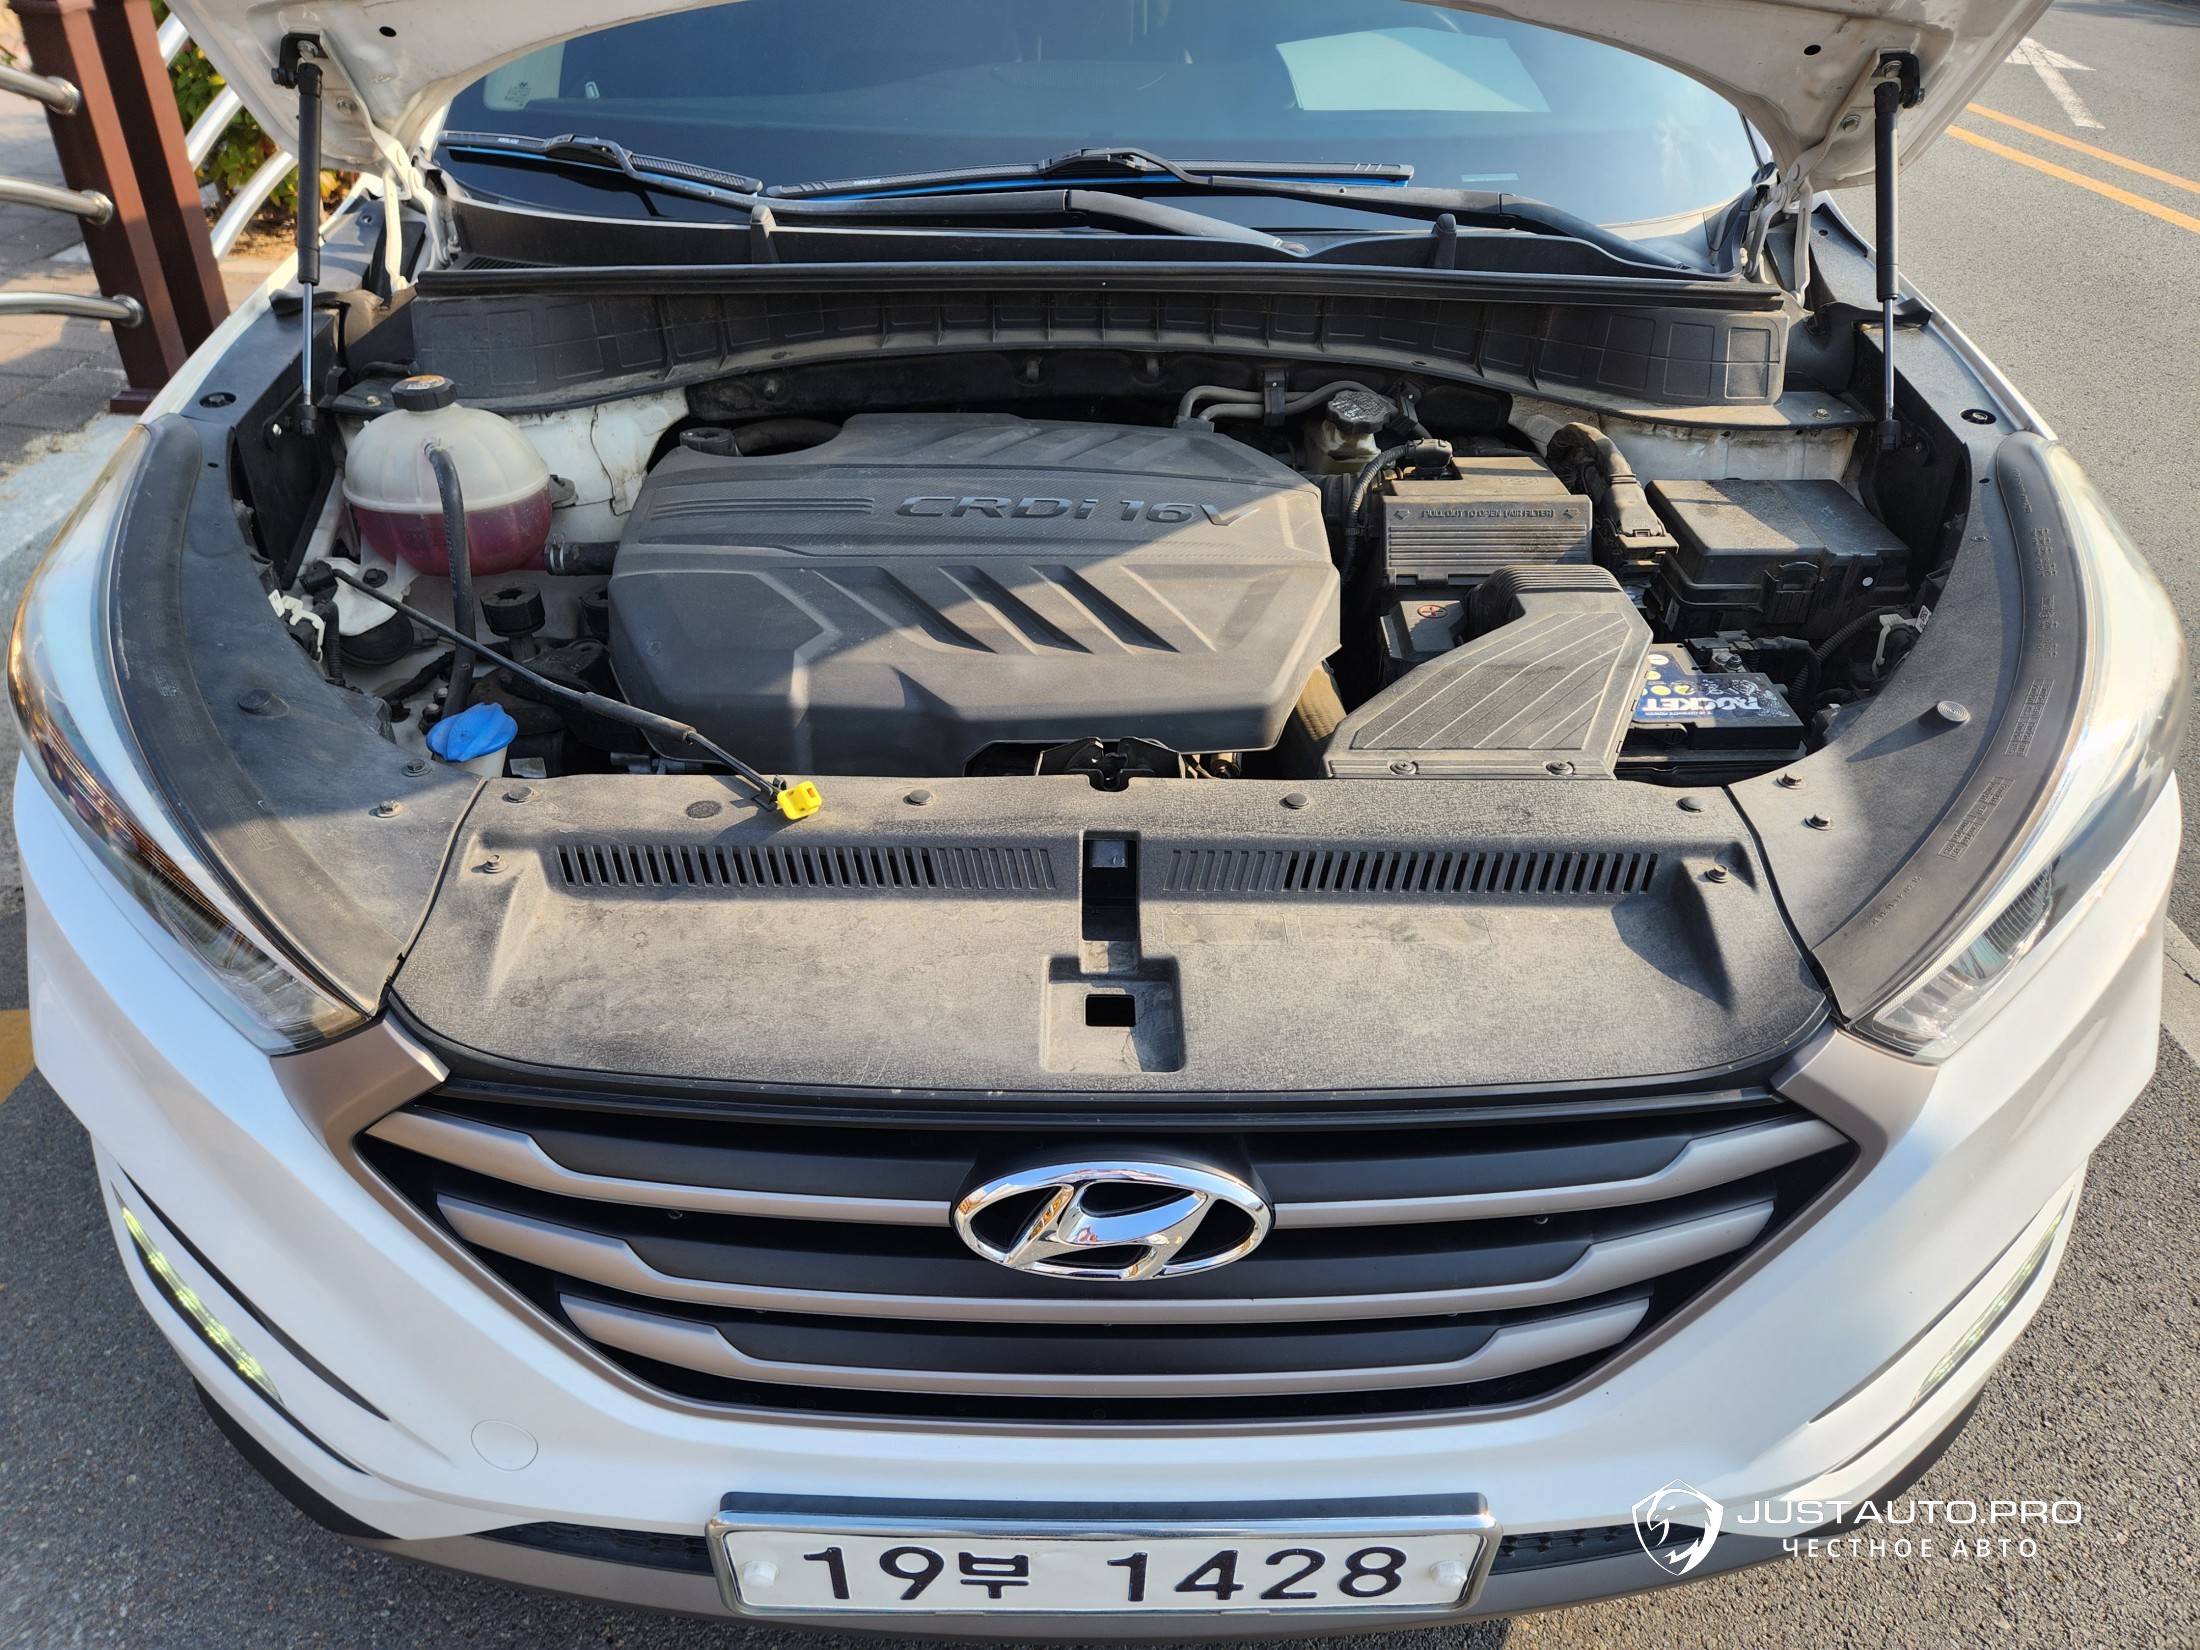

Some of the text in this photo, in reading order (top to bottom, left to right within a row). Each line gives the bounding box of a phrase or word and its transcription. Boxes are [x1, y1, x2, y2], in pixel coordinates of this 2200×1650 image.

[896, 496, 1261, 527] CRDi 16V
[1421, 509, 1445, 518] PULL
[1445, 509, 1464, 518] OUT
[1464, 509, 1476, 518] TO
[1476, 509, 1502, 518] OPEN
[1642, 696, 1762, 711] ROCKET
[803, 1545, 1408, 1601] 19부 1428
